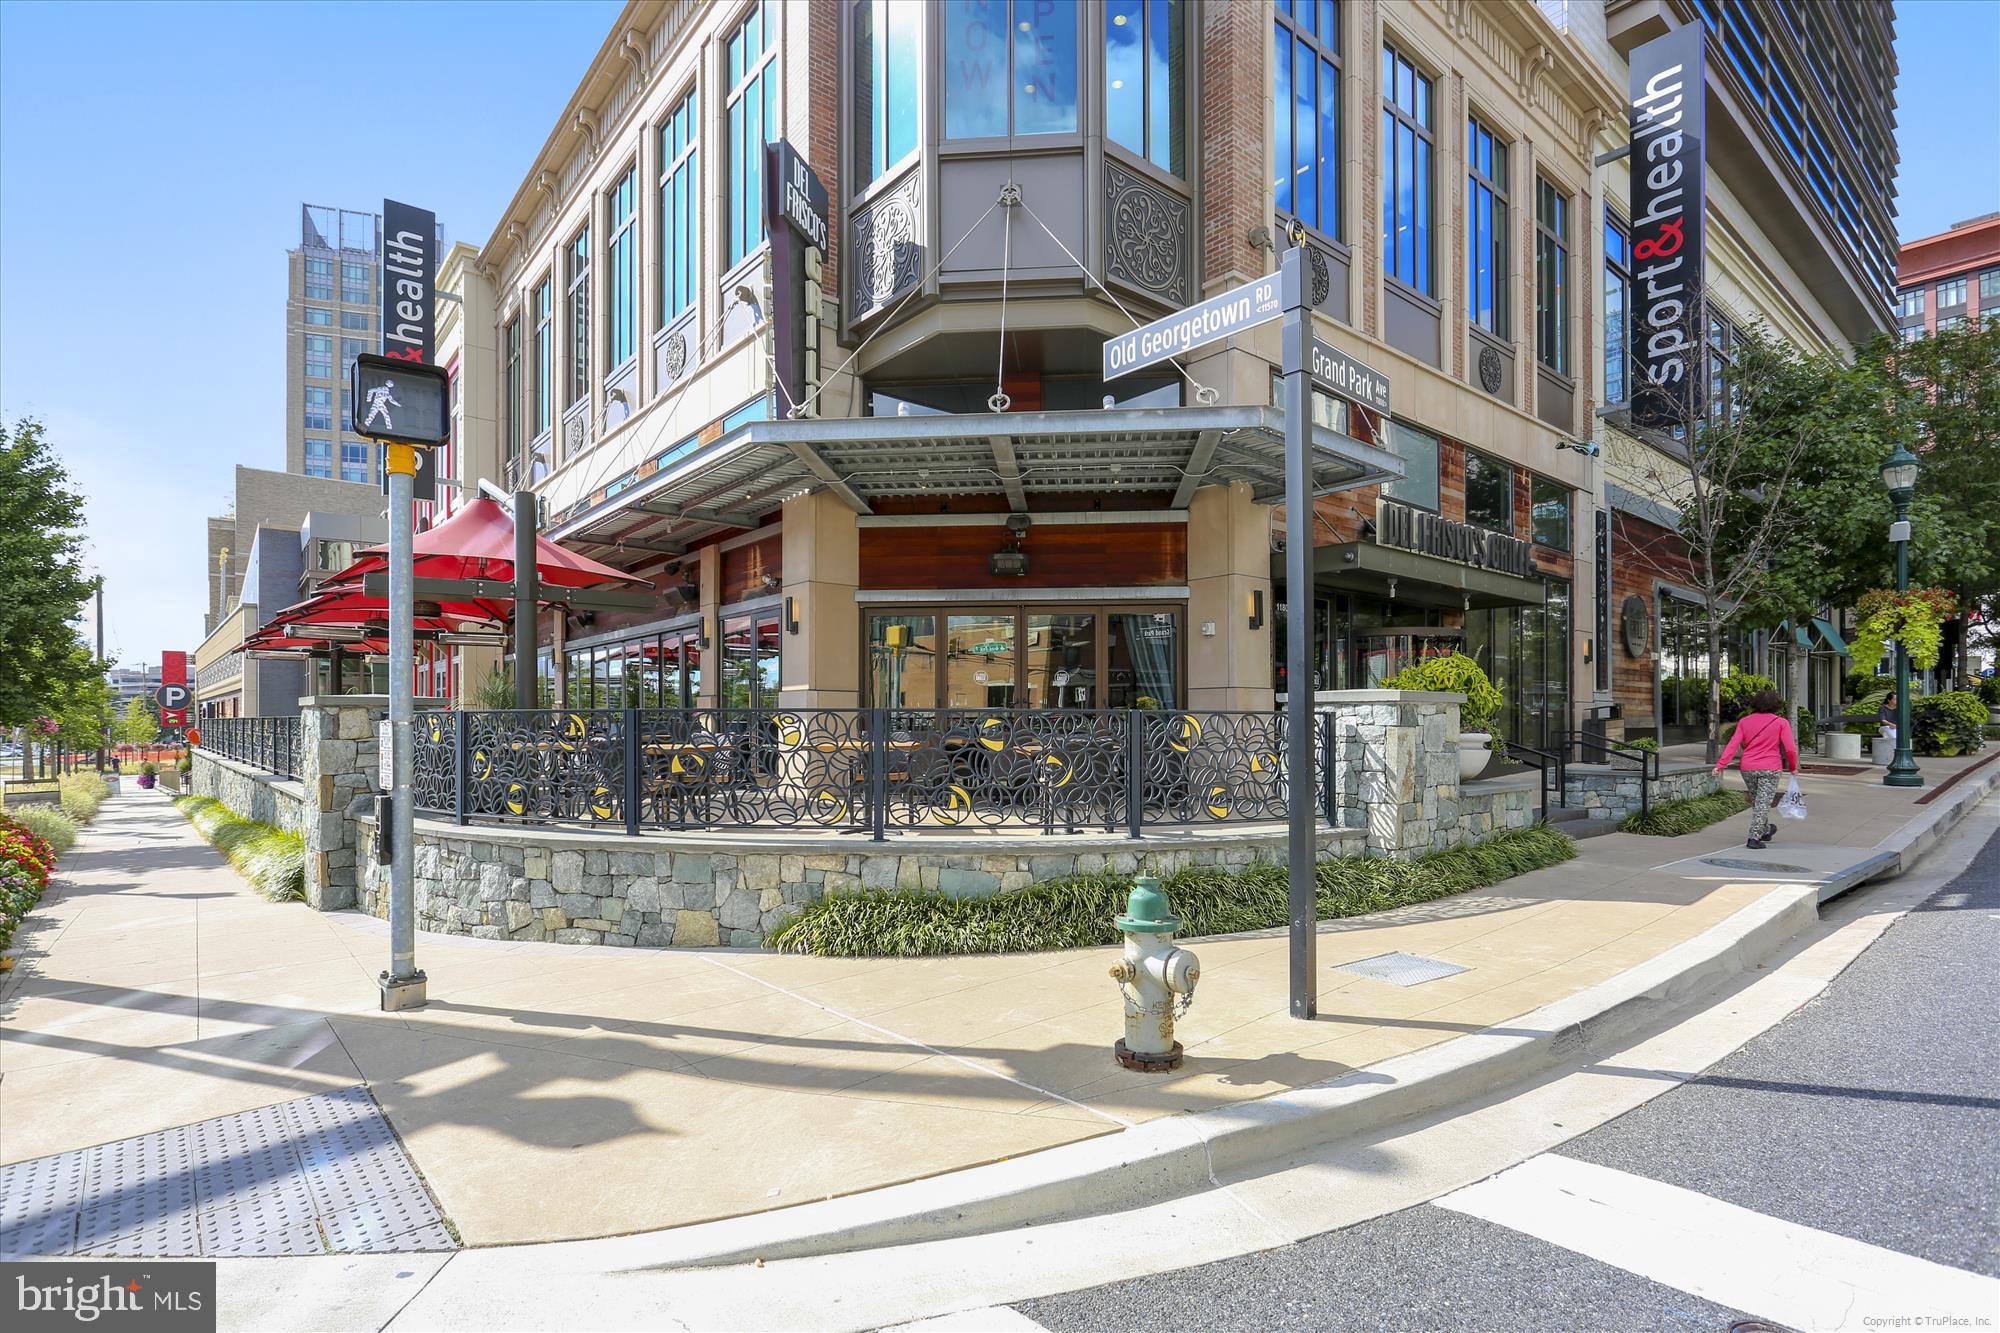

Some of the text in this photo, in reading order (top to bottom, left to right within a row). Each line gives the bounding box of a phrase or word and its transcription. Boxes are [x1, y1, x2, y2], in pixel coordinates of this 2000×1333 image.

[794, 156, 811, 202] DEL
[786, 185, 827, 251] FRISCO'S
[1110, 284, 1272, 369] Old Georgetown RD
[1312, 346, 1387, 401] Grand Park Ave
[1382, 502, 1418, 549] DEL
[166, 687, 186, 707] P
